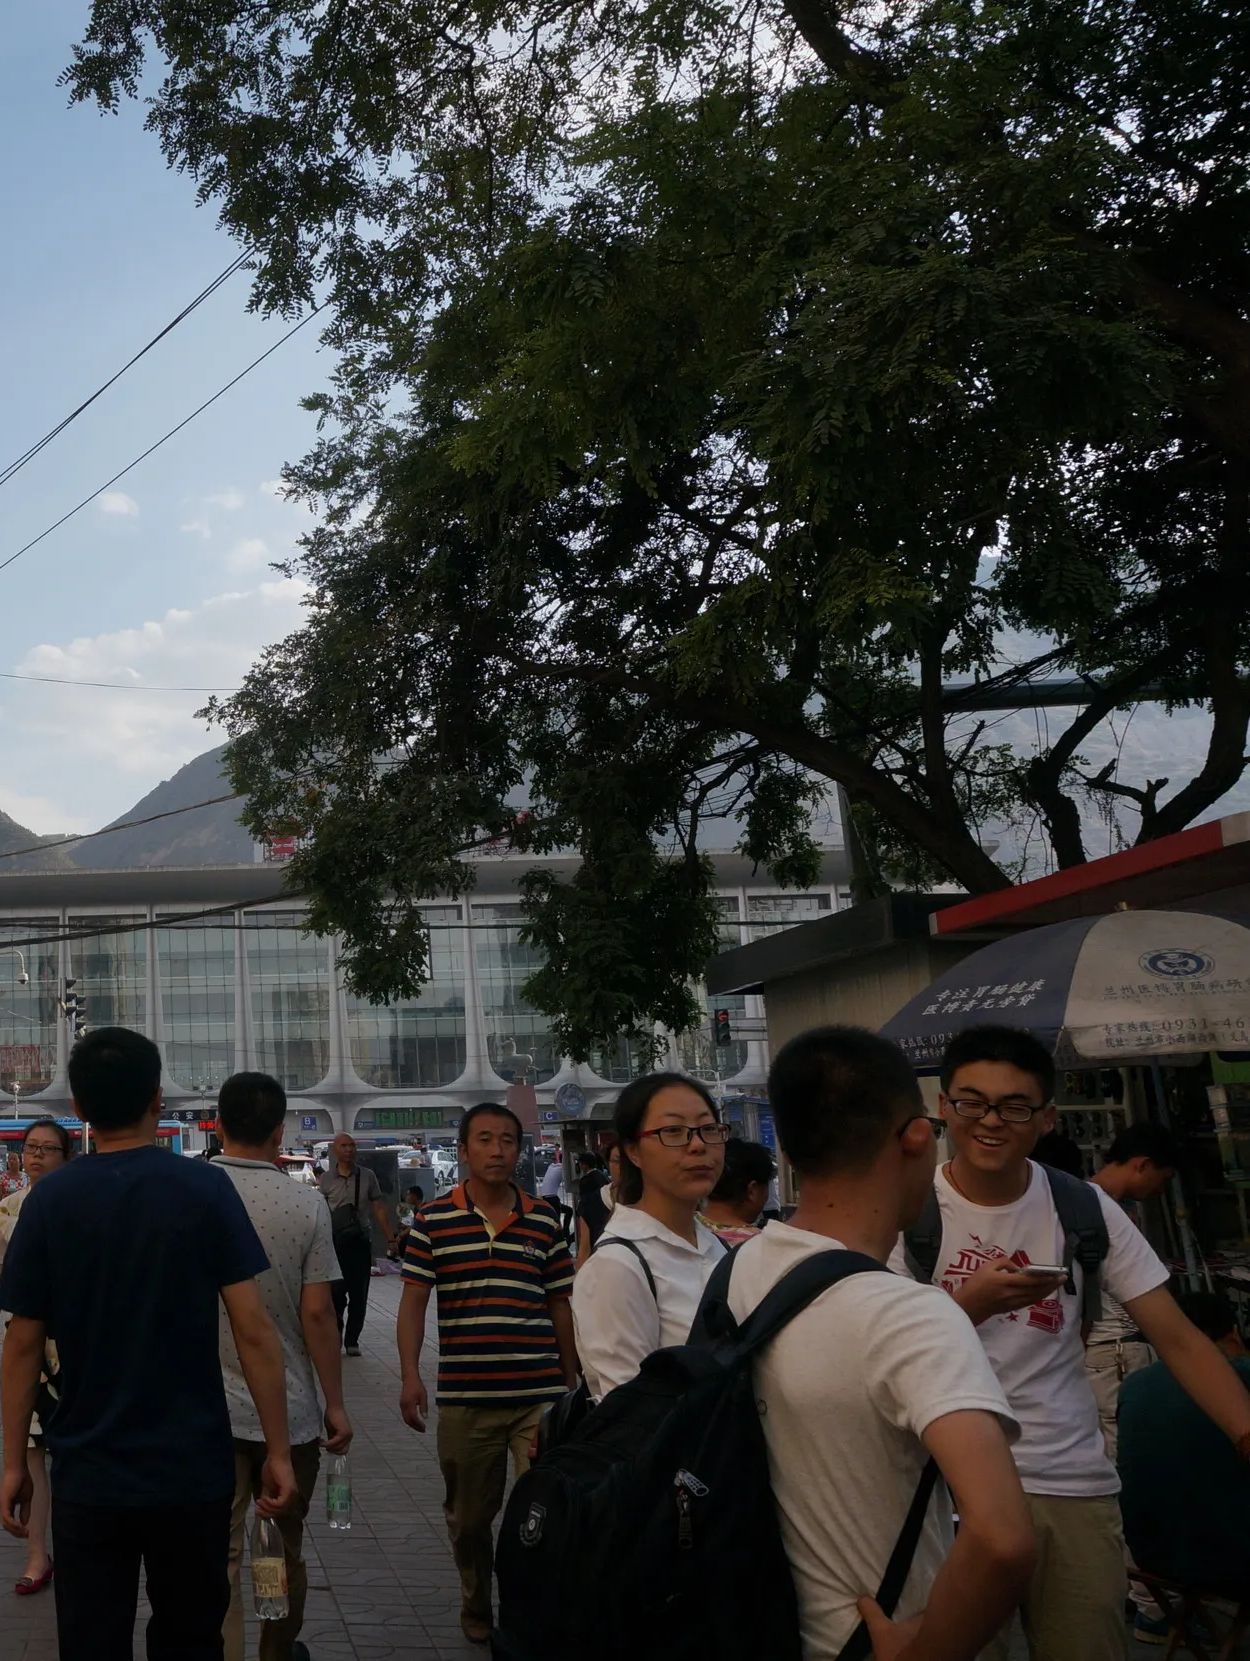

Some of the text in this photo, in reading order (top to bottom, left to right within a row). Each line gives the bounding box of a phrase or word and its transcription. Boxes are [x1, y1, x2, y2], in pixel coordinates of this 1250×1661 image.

[937, 978, 1046, 1002] 专注胃肠健康
[171, 1111, 194, 1120] 公安
[545, 1112, 554, 1120] C
[304, 1117, 311, 1125] B
